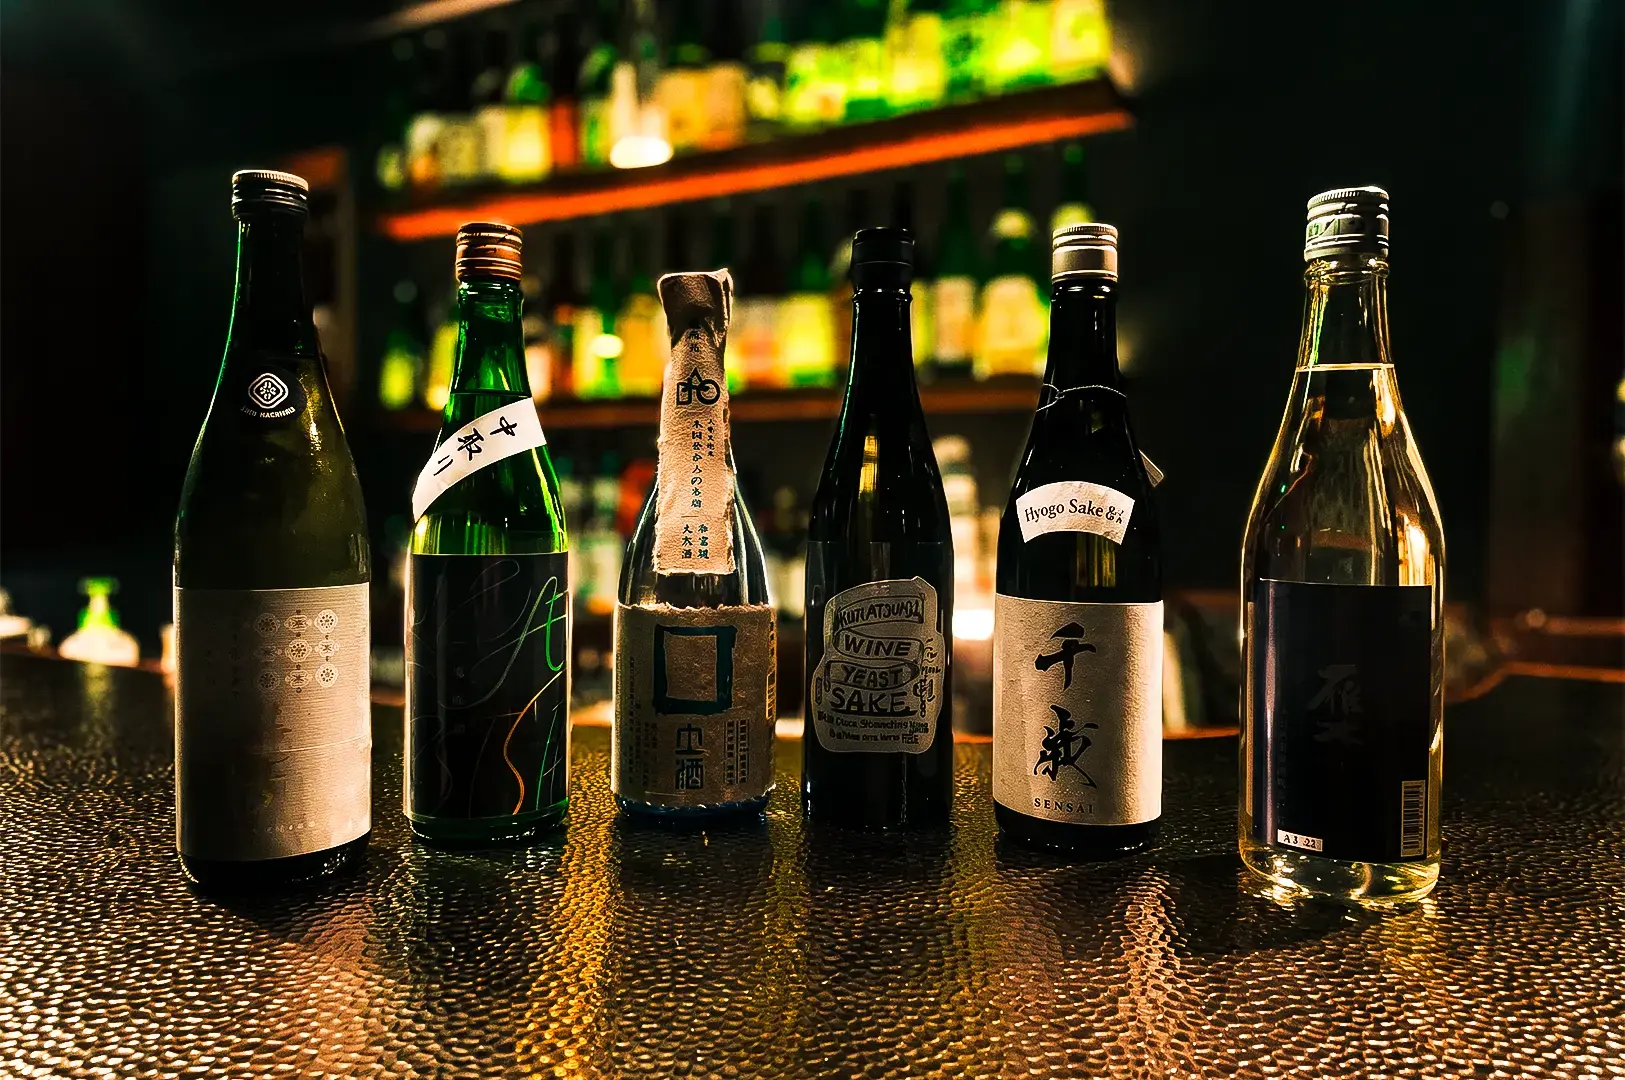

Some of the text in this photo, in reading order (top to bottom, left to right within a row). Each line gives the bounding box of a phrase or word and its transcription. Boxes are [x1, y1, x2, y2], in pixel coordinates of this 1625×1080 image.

[433, 416, 518, 476] 中取り
[1025, 503, 1065, 523] Hyogo
[1069, 498, 1104, 517] Sake
[844, 634, 912, 657] WINE
[841, 663, 903, 689] YEAST
[1034, 797, 1094, 814] SENSAI
